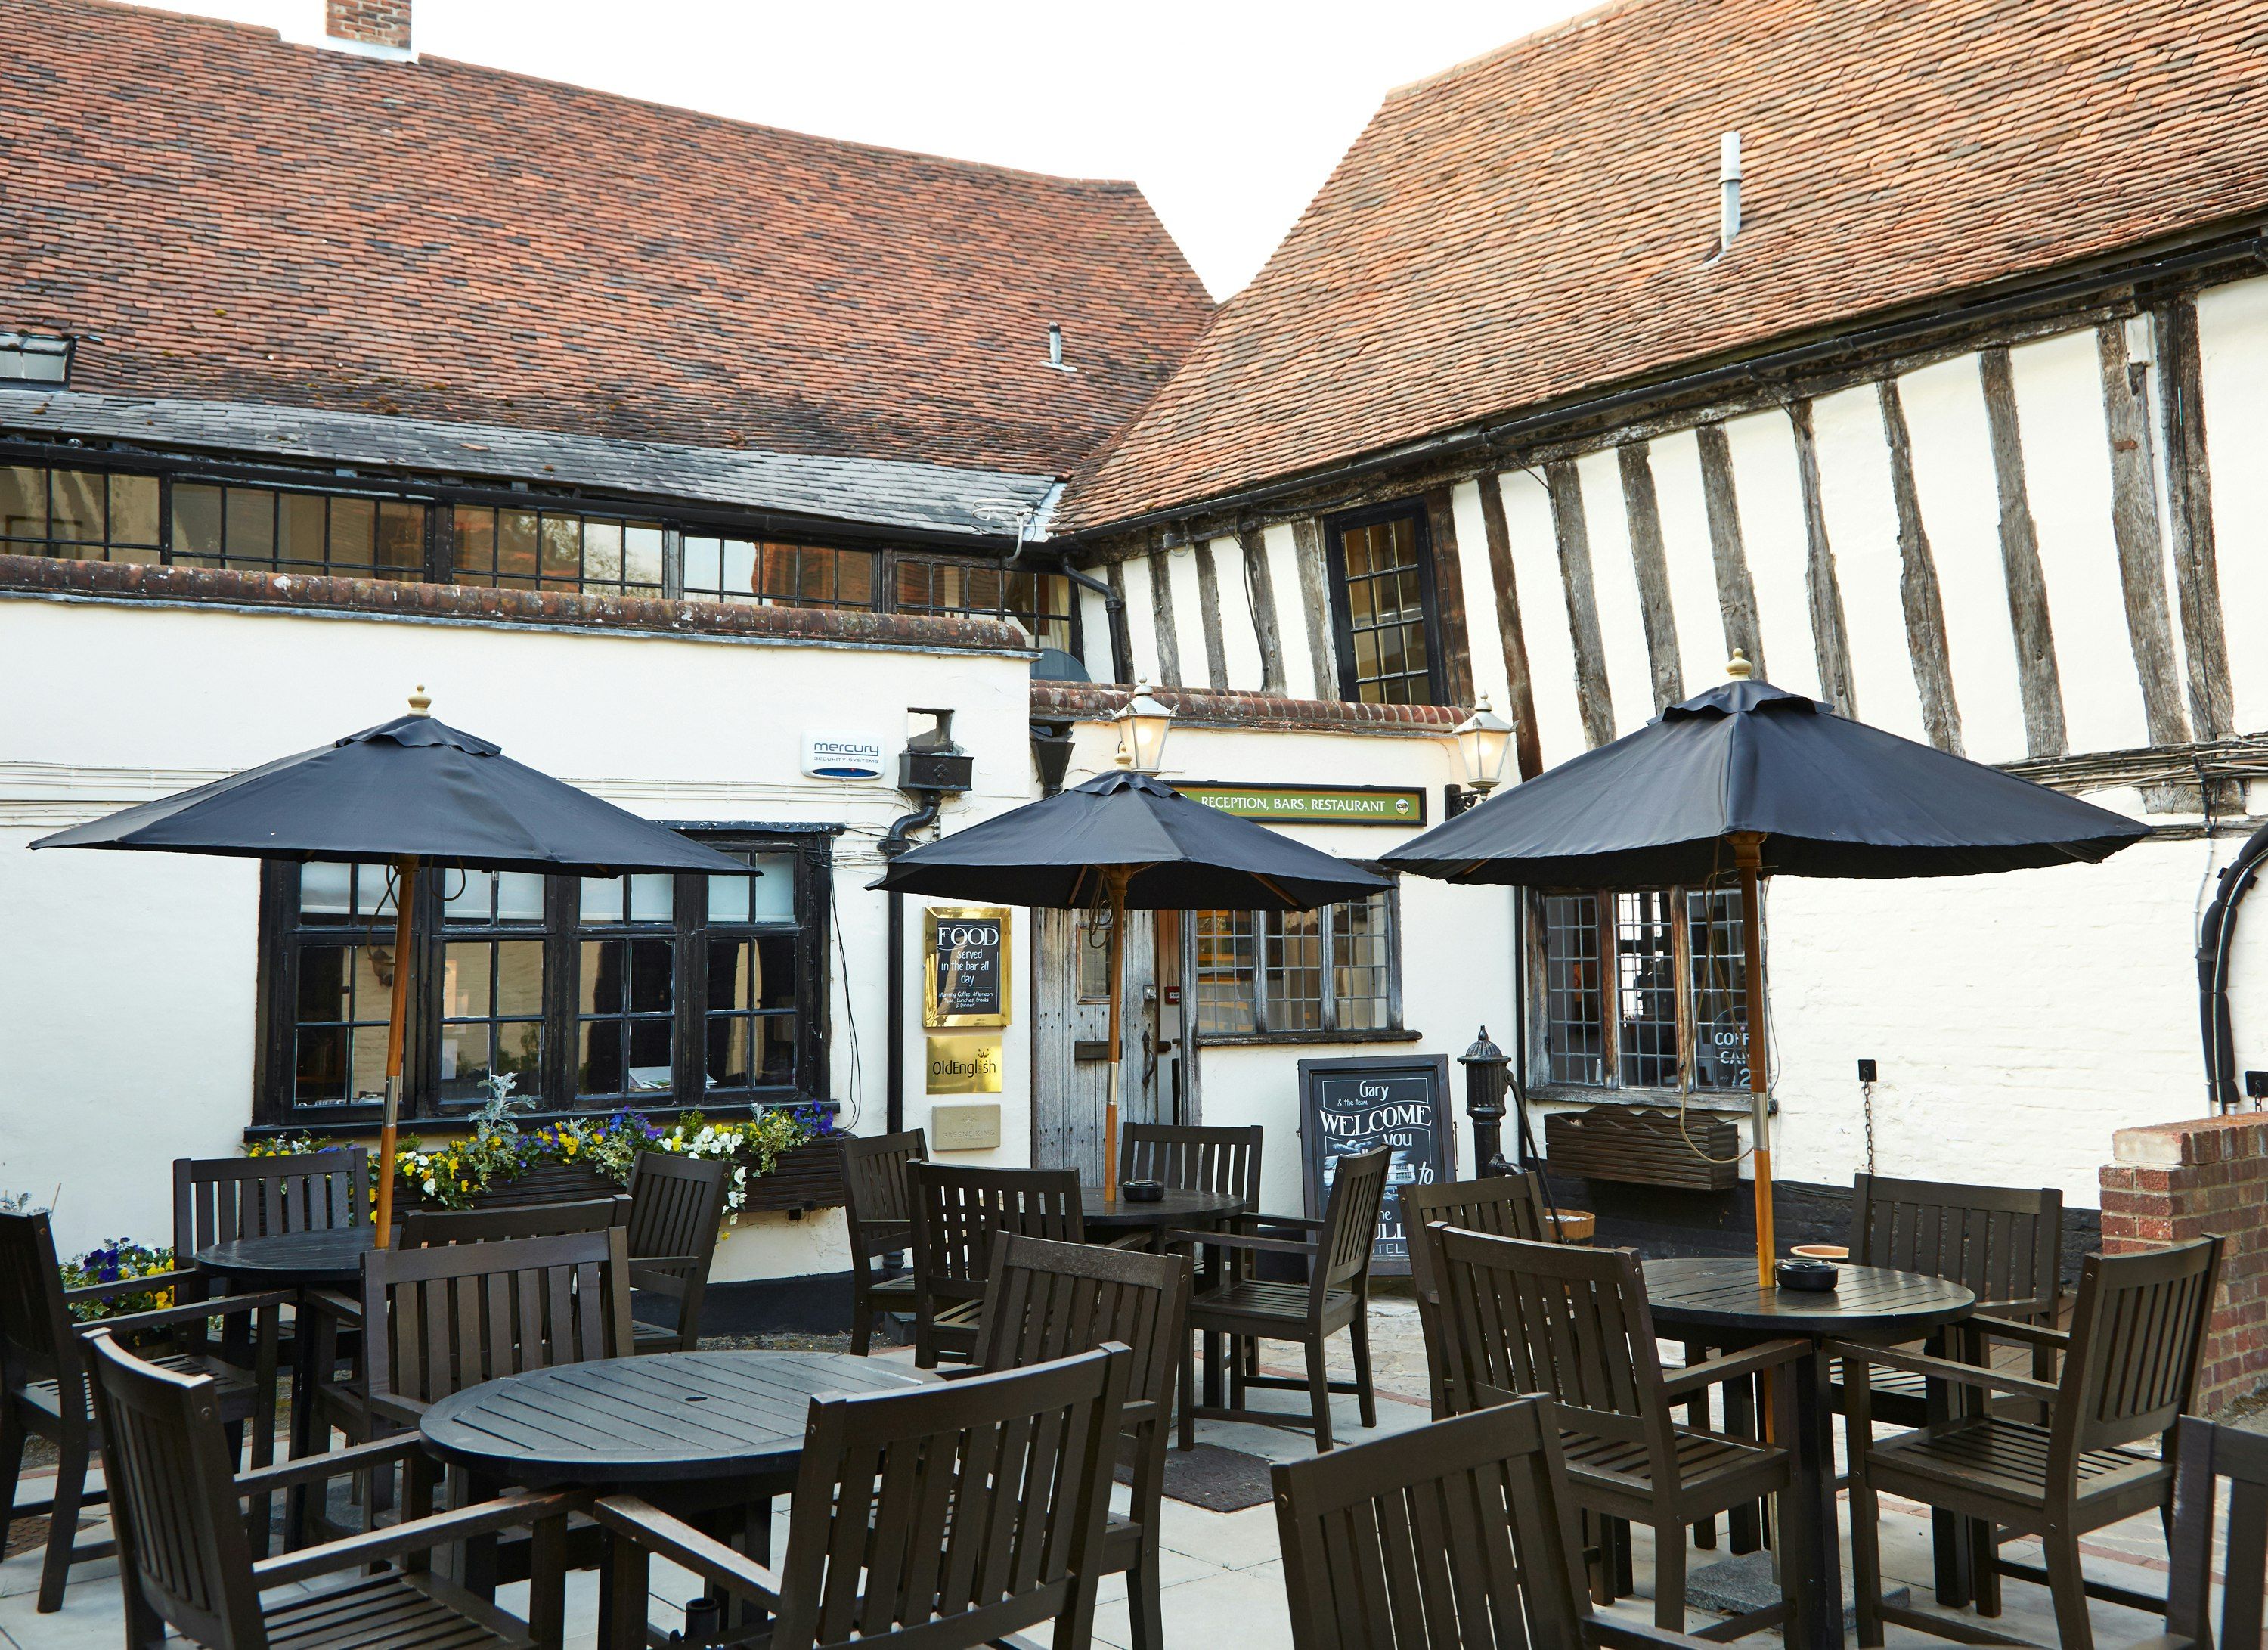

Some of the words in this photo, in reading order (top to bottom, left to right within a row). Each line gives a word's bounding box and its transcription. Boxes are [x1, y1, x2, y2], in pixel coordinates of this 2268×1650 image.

[814, 743, 879, 756] mercury
[1201, 796, 1269, 811] RECEPTION,
[1274, 798, 1308, 811] BARS,
[1311, 799, 1385, 812] RESTAURANT
[937, 927, 999, 946] FOOD
[956, 948, 983, 960] served
[941, 961, 949, 971] in
[950, 960, 964, 971] the
[965, 960, 980, 971] bar
[981, 960, 990, 971] all
[961, 971, 974, 987] day
[1359, 1081, 1389, 1101] Gary
[1337, 1099, 1342, 1107] &
[1319, 1104, 1432, 1137] WELCOME
[1418, 1161, 1434, 1185] to
